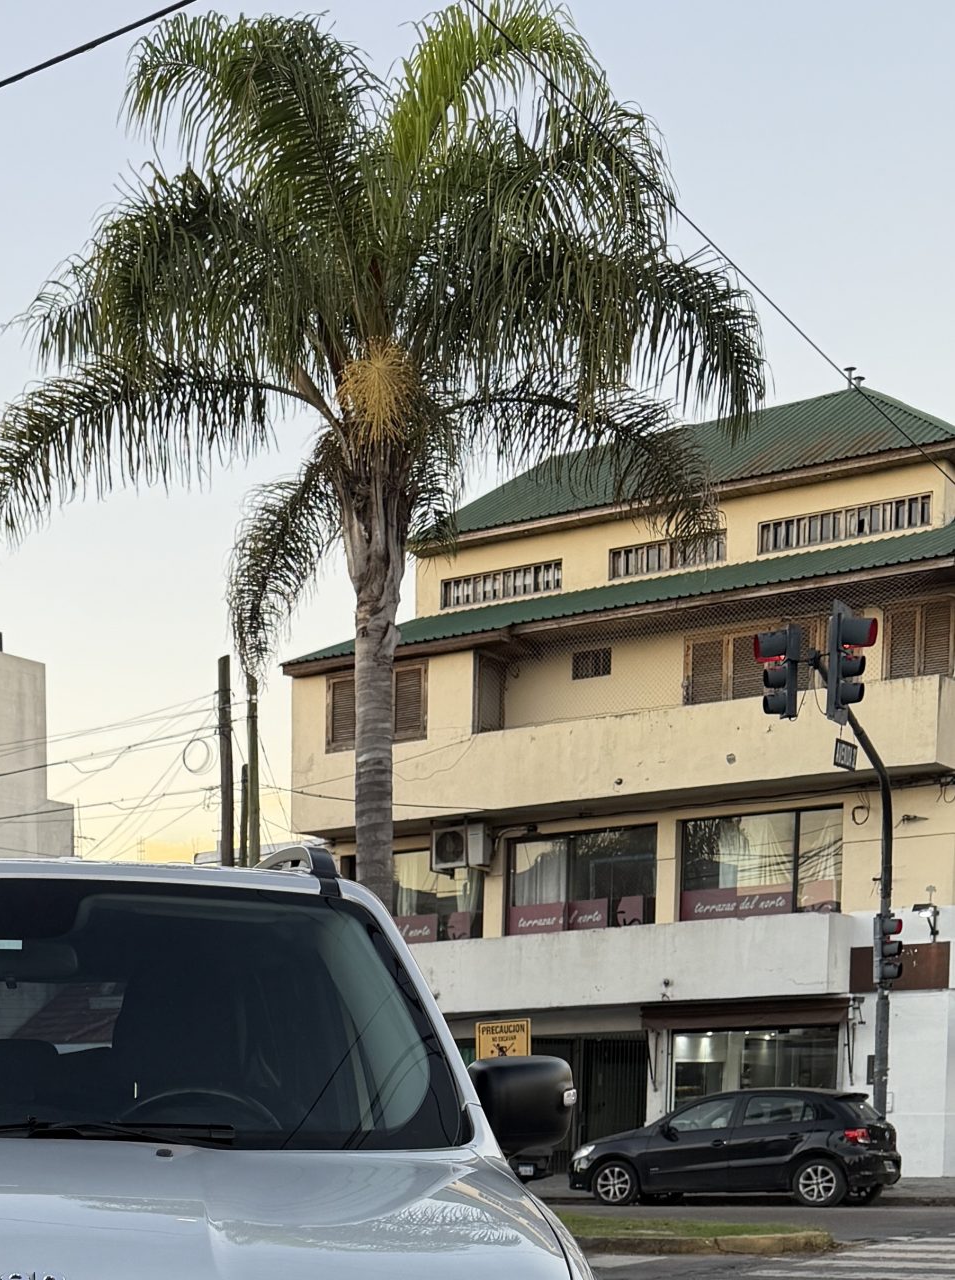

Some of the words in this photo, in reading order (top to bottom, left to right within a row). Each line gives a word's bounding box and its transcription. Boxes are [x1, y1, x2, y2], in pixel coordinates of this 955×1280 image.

[694, 902, 737, 914] terrazas
[739, 895, 759, 910] del
[759, 896, 786, 910] norte
[518, 916, 556, 928] terrazas
[577, 910, 603, 923] norte
[481, 1023, 525, 1035] PRECAUCION
